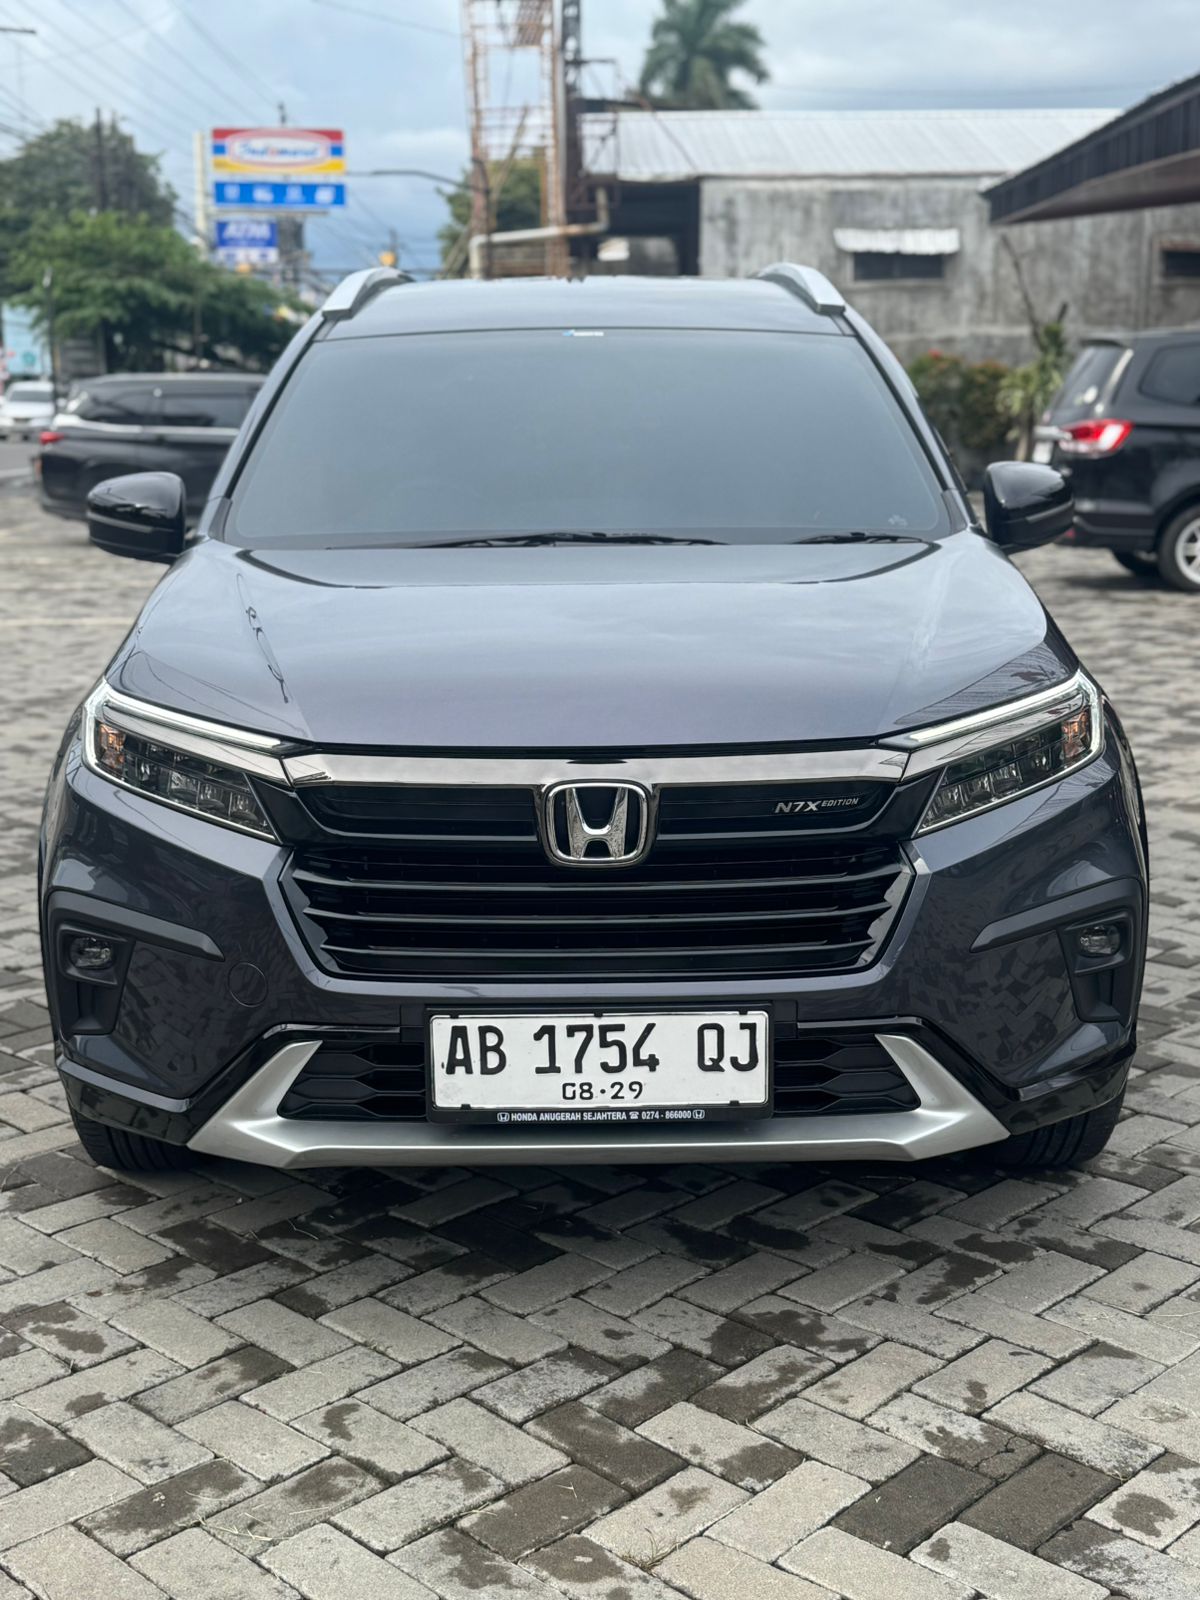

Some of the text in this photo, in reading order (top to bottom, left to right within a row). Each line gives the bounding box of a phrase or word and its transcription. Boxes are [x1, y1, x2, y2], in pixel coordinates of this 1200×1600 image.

[774, 798, 859, 813] N7X EDITION
[445, 1022, 759, 1075] AB 1754 QJ
[511, 1112, 537, 1121] HONDA
[539, 1112, 581, 1121] ANUGERAH
[583, 1111, 627, 1120] SEJAHTERA
[641, 1111, 660, 1119] 0274
[665, 1110, 692, 1119] 866000
